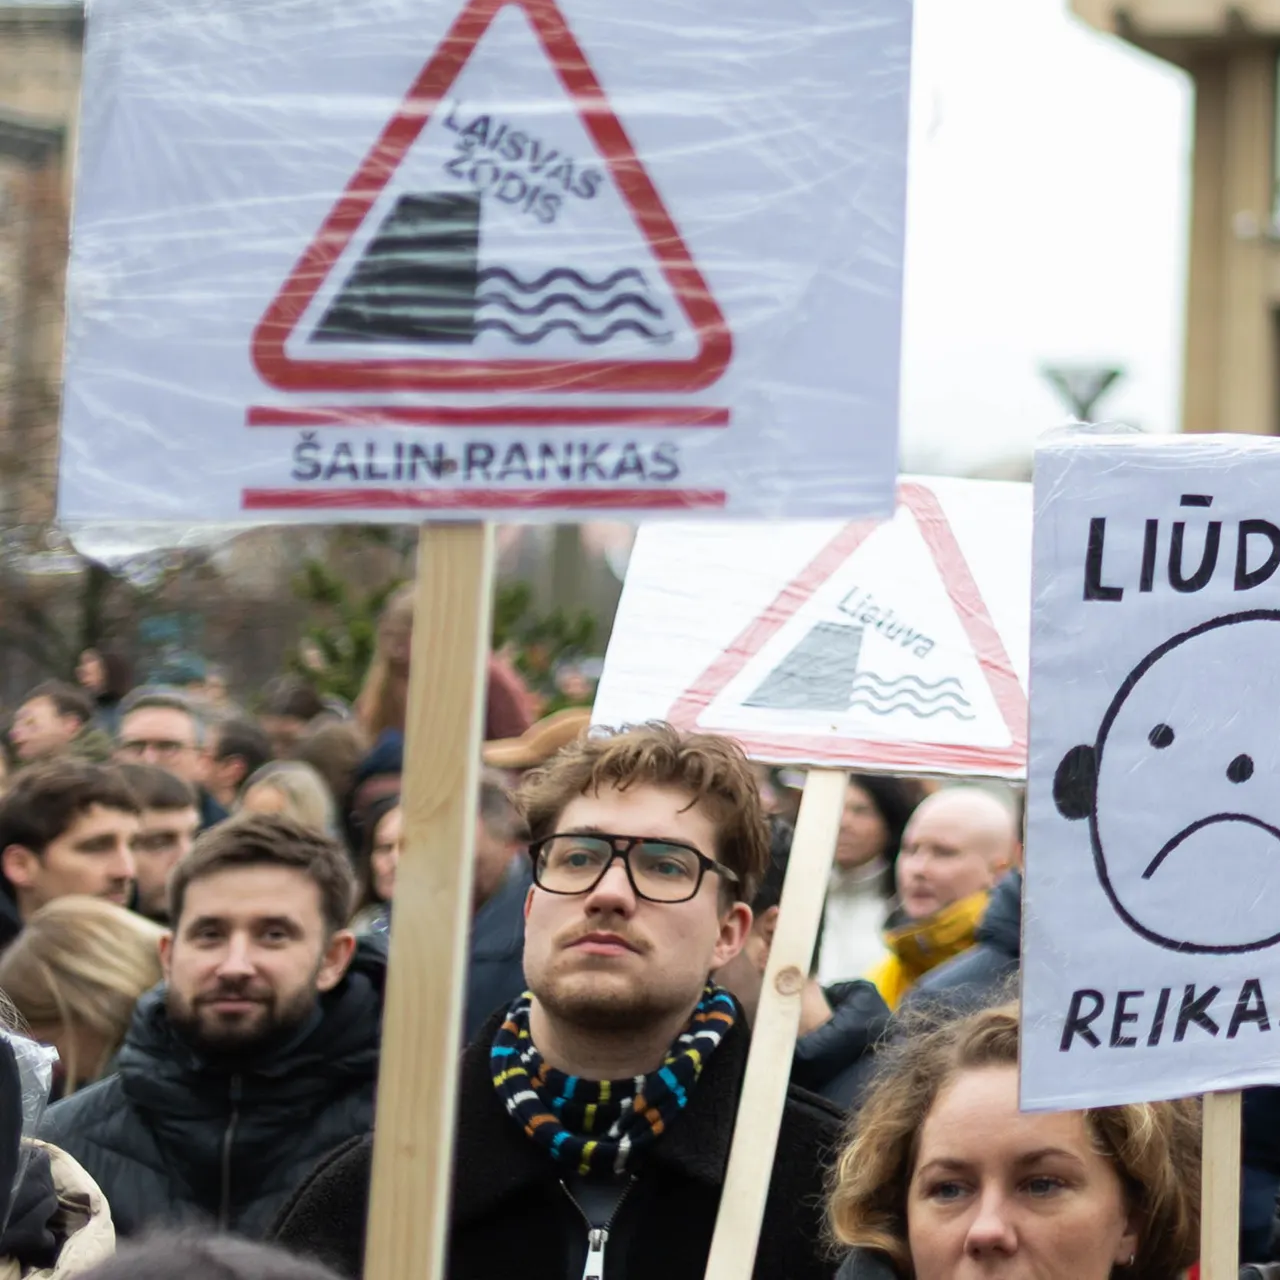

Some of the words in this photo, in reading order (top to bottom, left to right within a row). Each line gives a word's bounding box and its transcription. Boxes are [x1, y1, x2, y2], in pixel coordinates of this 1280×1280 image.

[442, 100, 604, 200] LAISVAS
[442, 138, 564, 224] ŽODIS
[290, 431, 444, 482] ŠALIN
[463, 439, 681, 482] RANKAS
[837, 585, 936, 658] Lietuva
